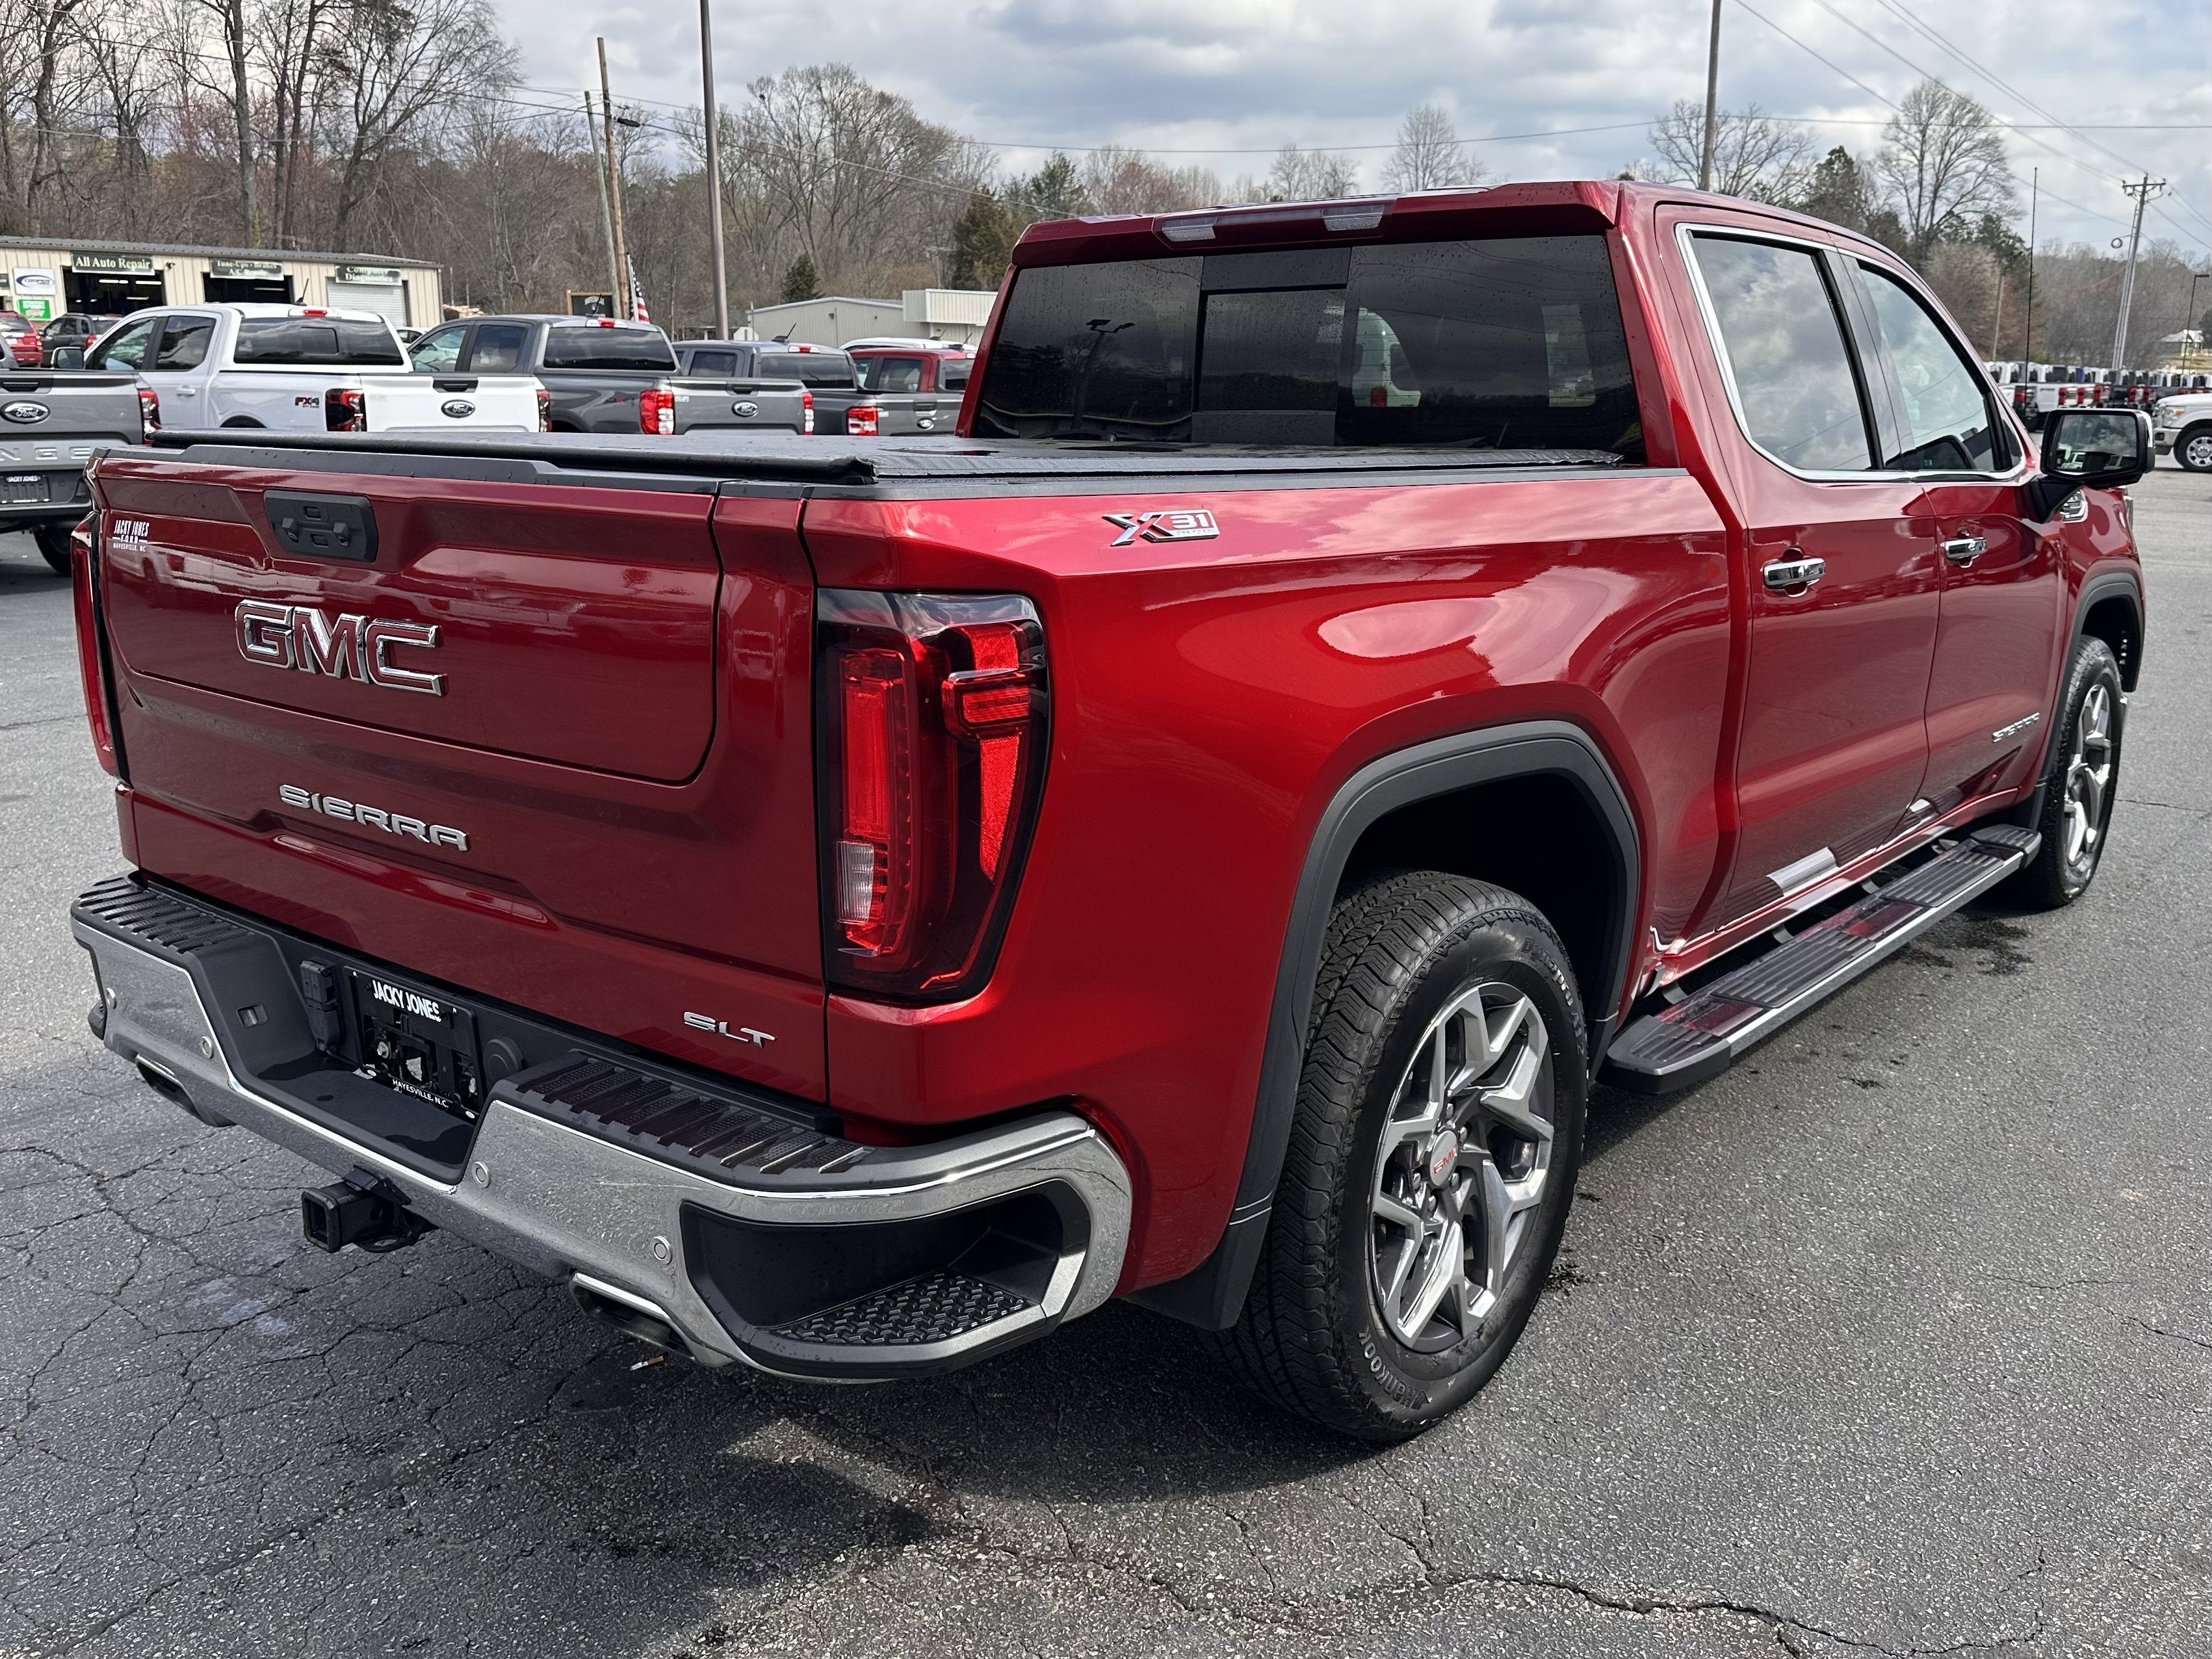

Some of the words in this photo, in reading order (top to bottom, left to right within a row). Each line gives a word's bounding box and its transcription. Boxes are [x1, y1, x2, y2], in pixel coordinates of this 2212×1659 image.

[76, 257, 90, 267] All
[92, 257, 116, 268] Auto
[118, 257, 151, 272] Repair
[294, 397, 320, 406] FX4
[114, 519, 132, 535] JACKY
[131, 521, 150, 537] JONES
[120, 534, 138, 544] FORD
[235, 599, 447, 697] GMC
[280, 784, 469, 852] SIERRA
[372, 980, 404, 1009] JACKY
[406, 991, 442, 1023] JONES
[684, 1012, 776, 1049] SLT
[435, 1096, 449, 1108] N.C.
